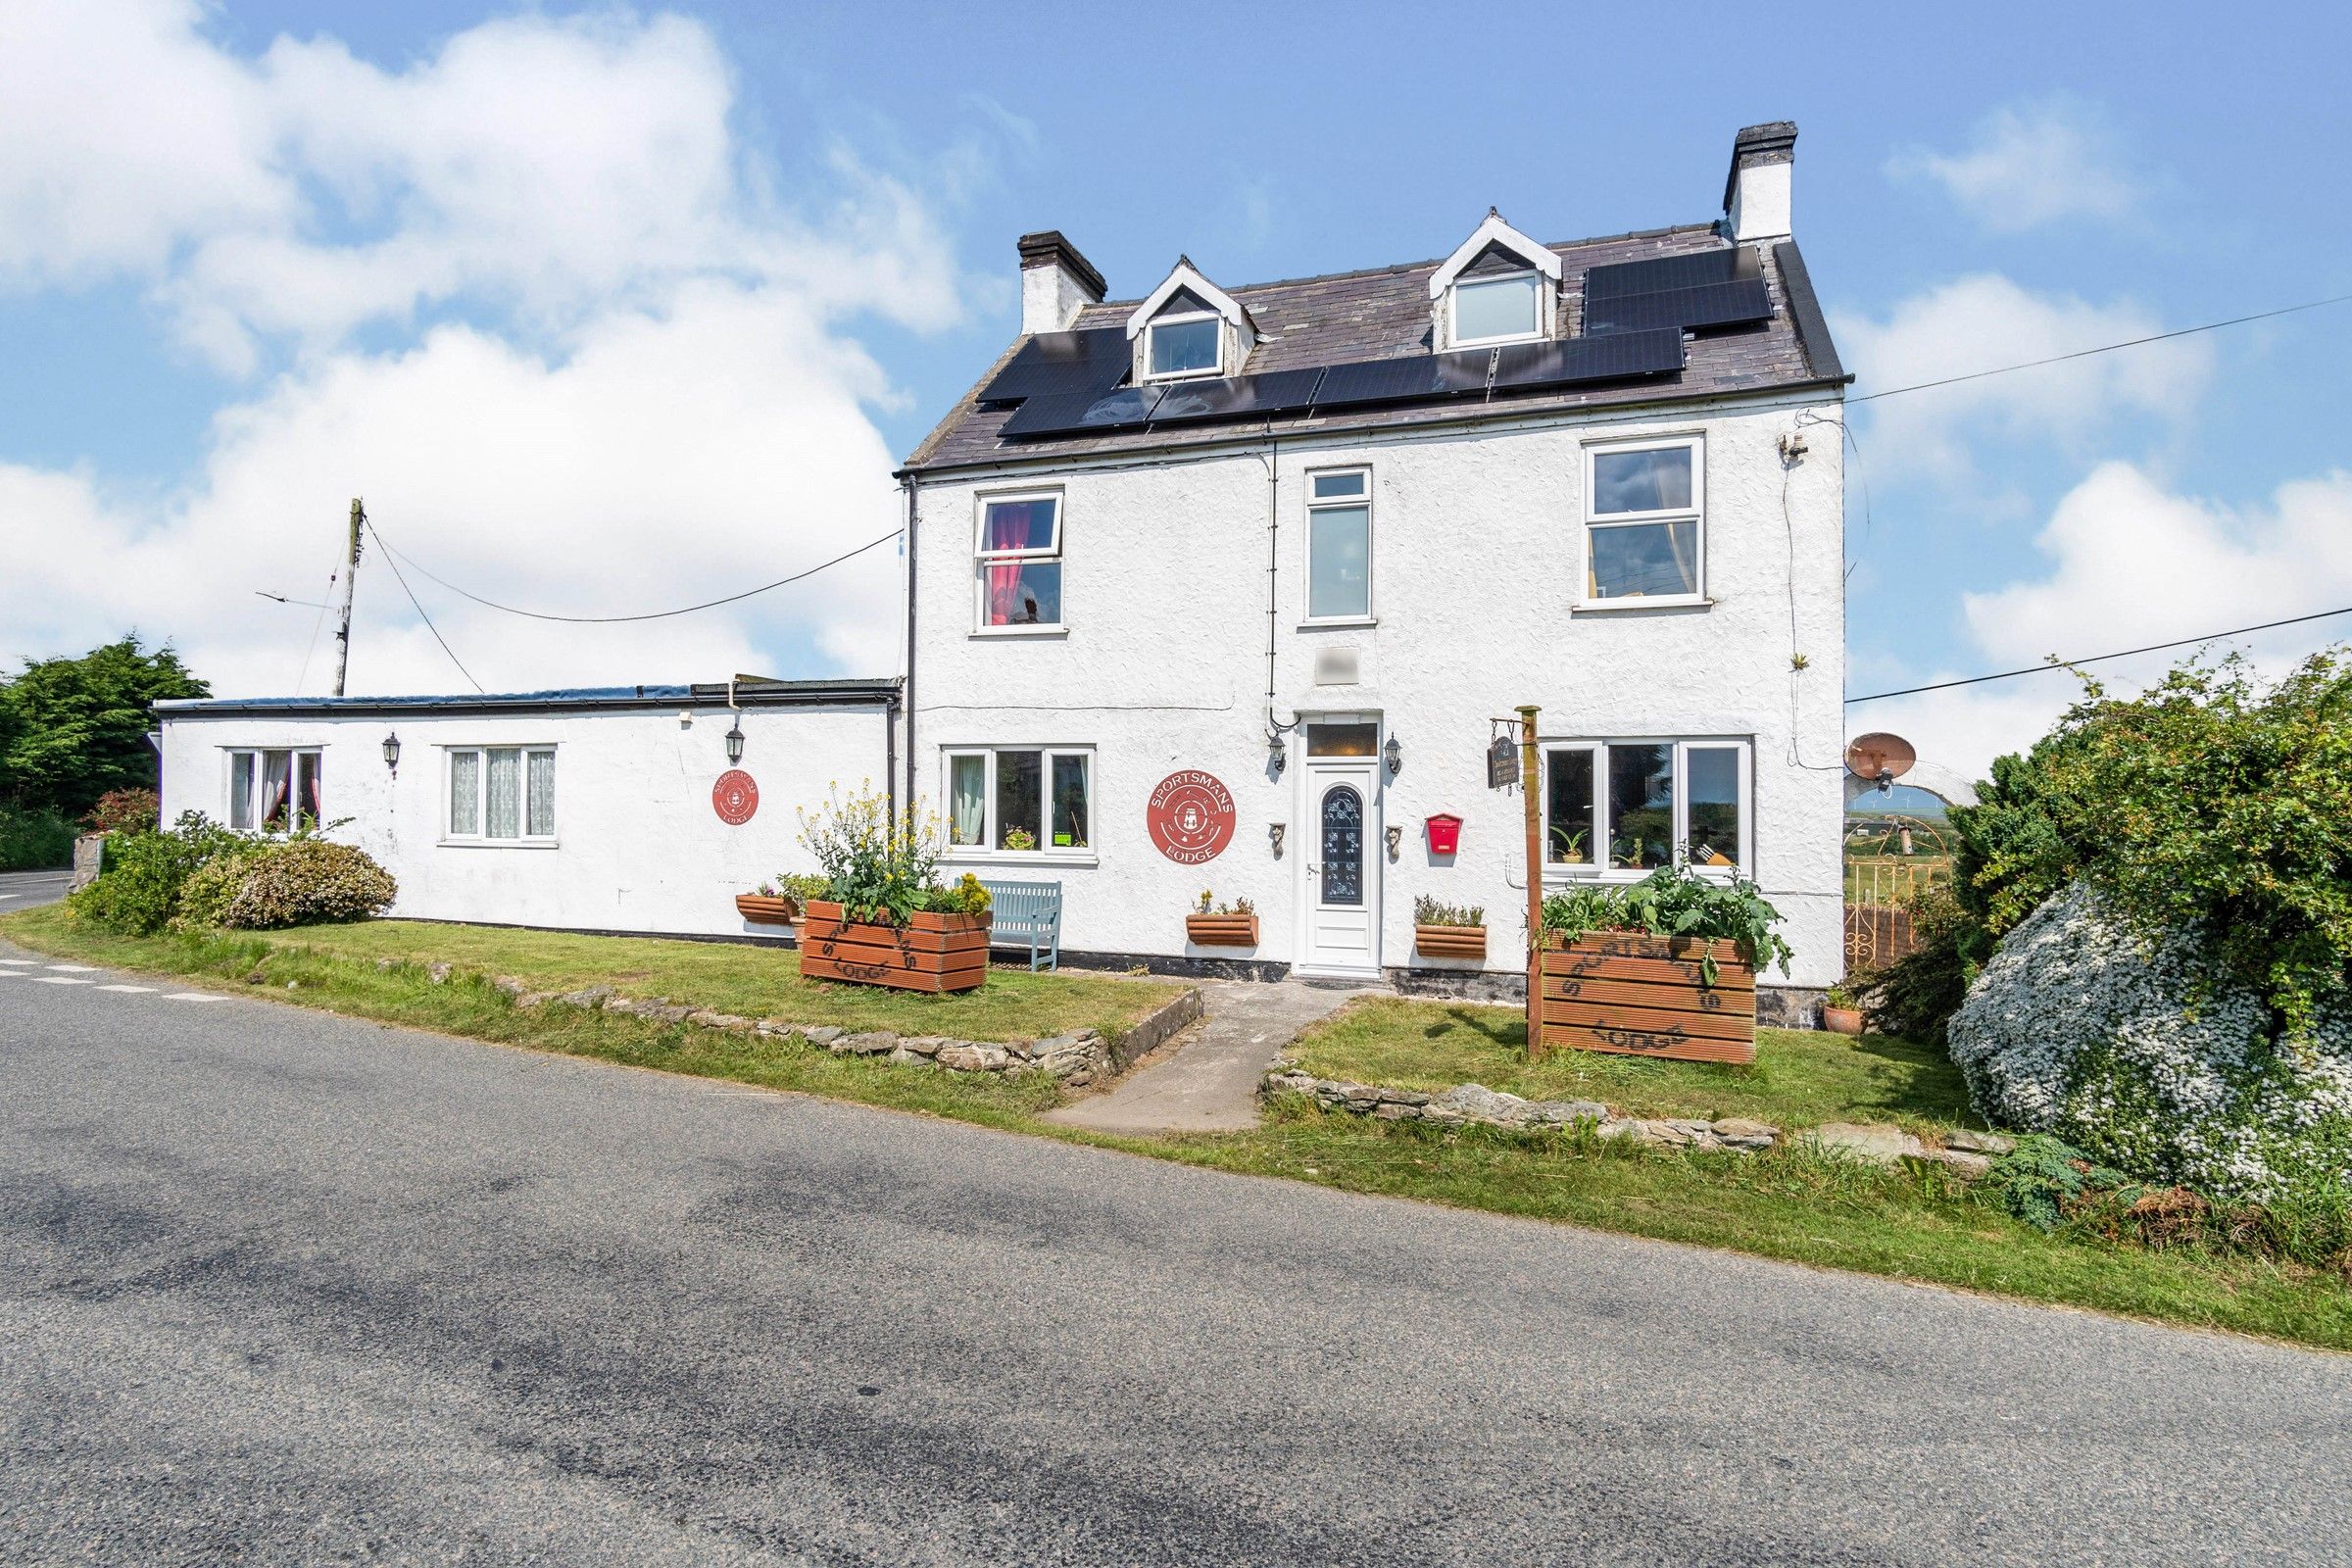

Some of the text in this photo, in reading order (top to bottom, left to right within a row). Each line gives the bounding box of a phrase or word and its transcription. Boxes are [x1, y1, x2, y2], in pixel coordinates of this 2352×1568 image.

[1152, 772, 1233, 813] SPORTSMANS
[1165, 845, 1216, 863] LODGE
[1592, 1018, 1690, 1052] LODGE
